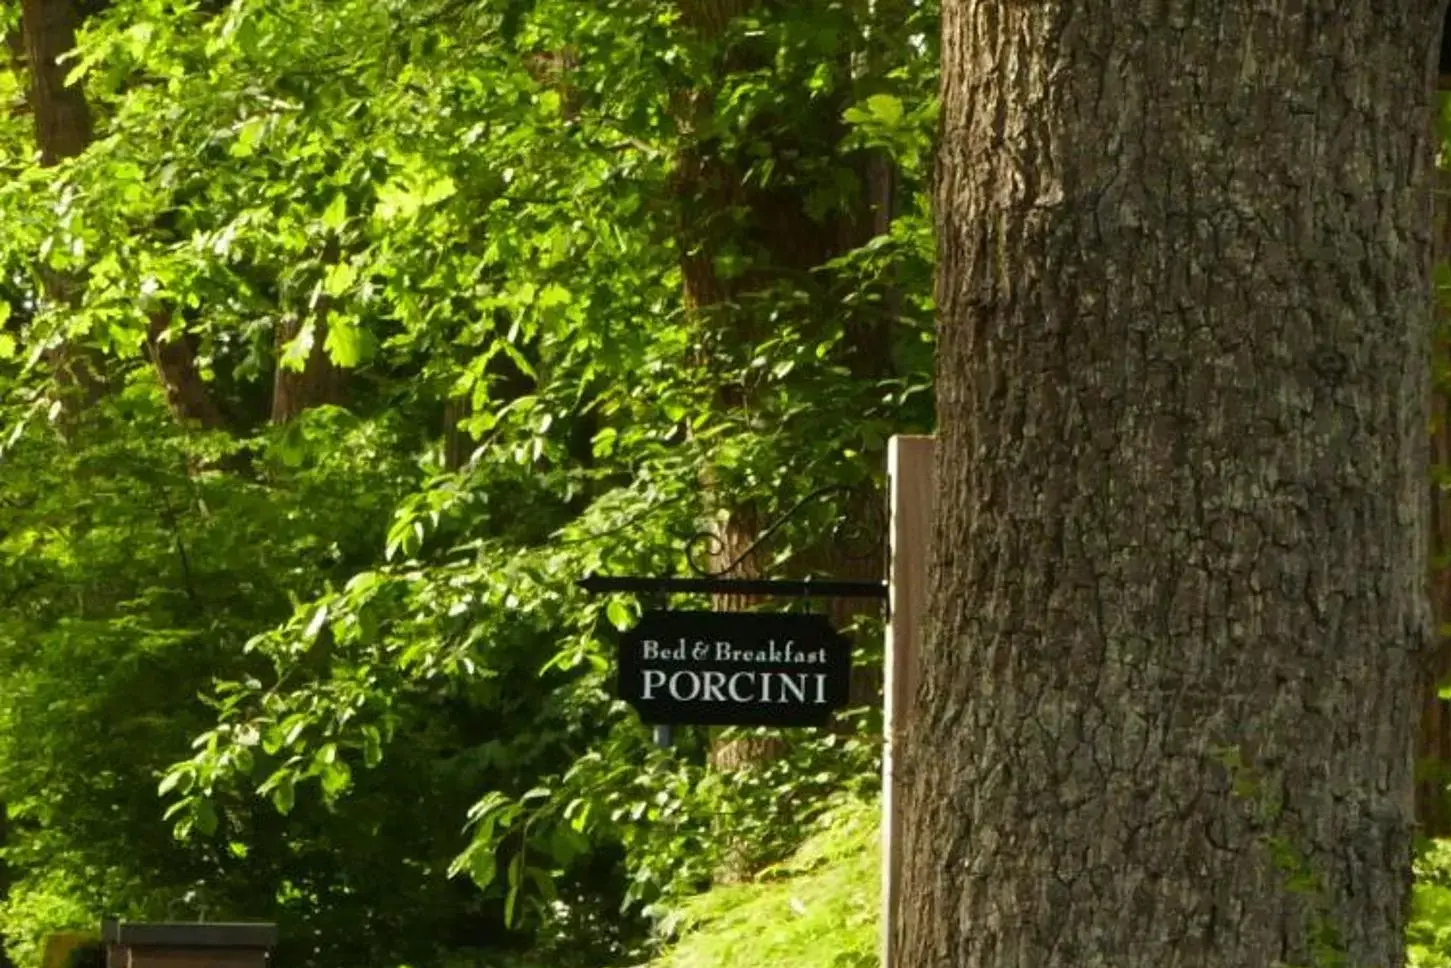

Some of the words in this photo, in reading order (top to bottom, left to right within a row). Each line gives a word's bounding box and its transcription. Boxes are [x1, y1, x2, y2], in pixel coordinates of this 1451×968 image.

[642, 638, 686, 661] Bed
[692, 641, 710, 661] &
[715, 640, 827, 663] Breakfast
[641, 670, 828, 703] PORCINI
